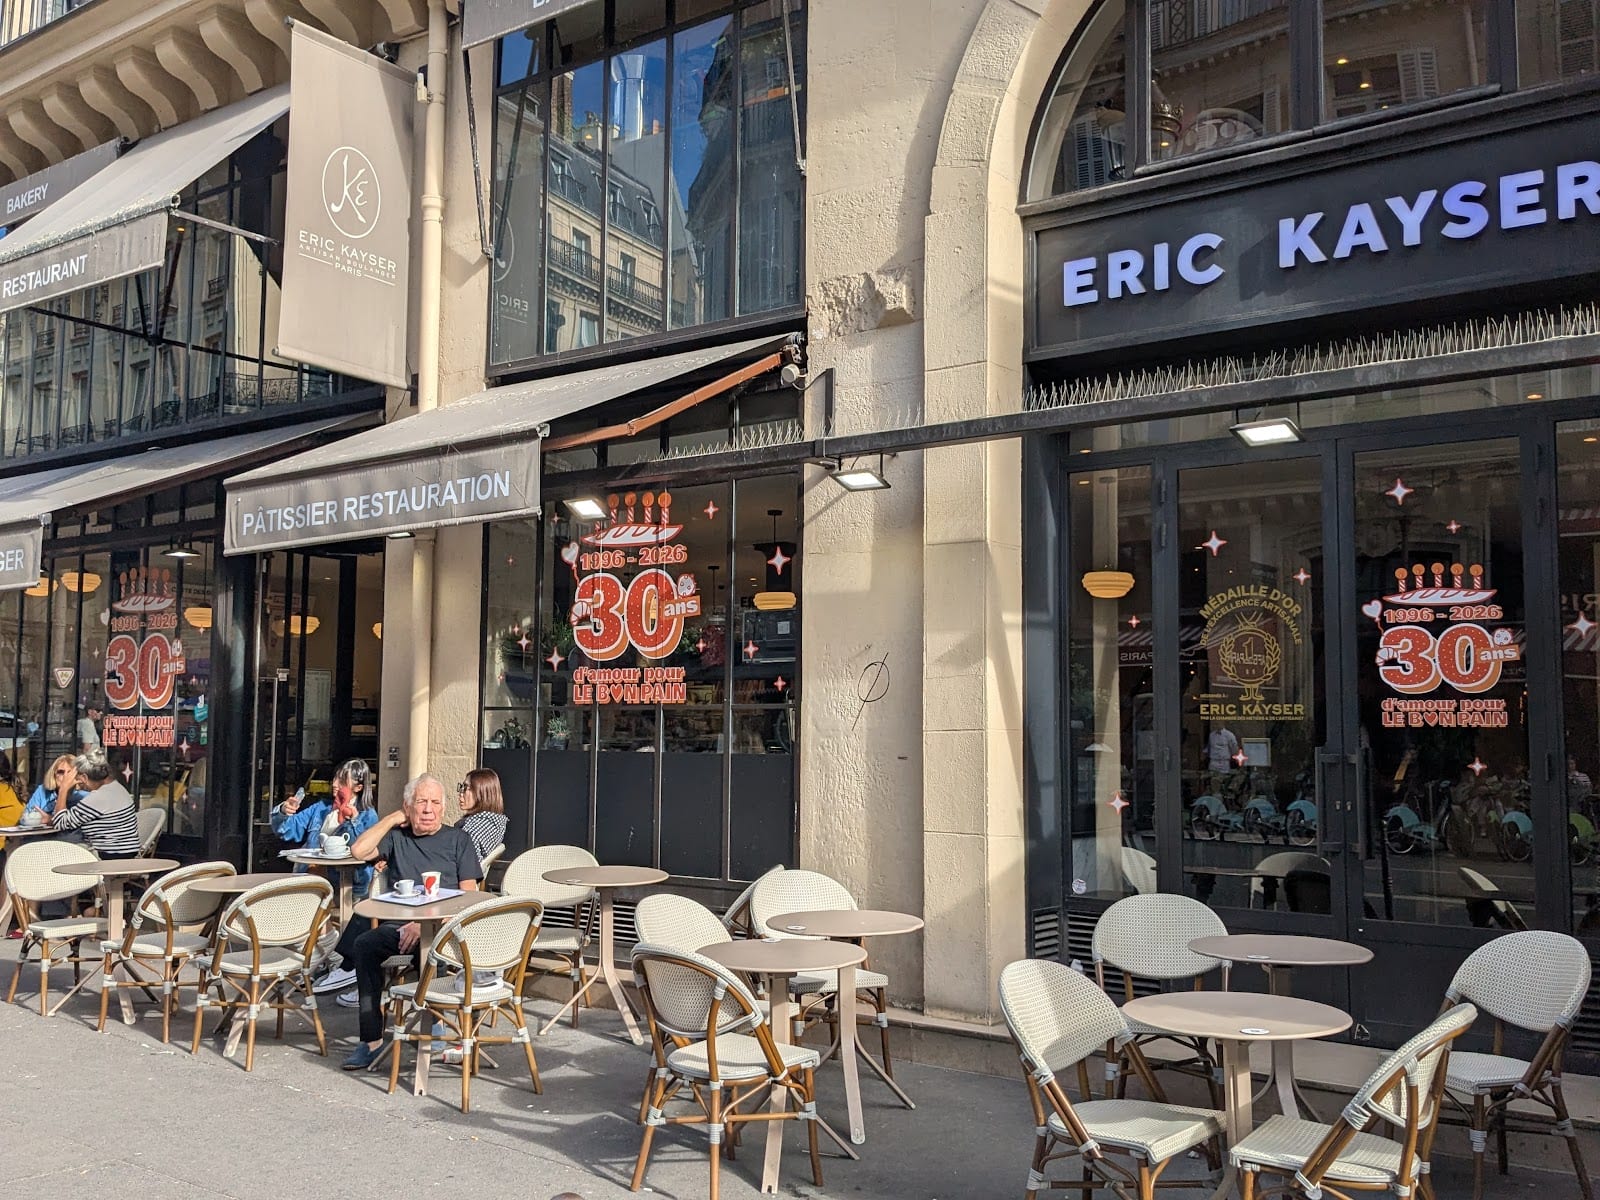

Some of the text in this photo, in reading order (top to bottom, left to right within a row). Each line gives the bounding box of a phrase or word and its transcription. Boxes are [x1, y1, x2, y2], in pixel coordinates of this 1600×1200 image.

[6, 183, 49, 214] BAKERY
[1063, 160, 1600, 307] ERIC KAYSER
[299, 230, 396, 272] ERIC KAYSER
[299, 244, 396, 279] ARTISAN BOULANGER
[2, 254, 88, 298] RESTAURANT
[335, 262, 362, 277] PARIS
[242, 470, 511, 536] PÂTISSIER RESTAURATION
[580, 550, 625, 570] 1996
[638, 544, 688, 566] 2026
[664, 599, 698, 617] ans
[1199, 584, 1302, 619] MÉDAILLE D'OR
[111, 616, 139, 632] 1996
[147, 613, 178, 630] 2026
[573, 568, 685, 661] 30
[1200, 599, 1302, 646] DE L'EXCELLENCE ARTISANALE
[1384, 608, 1434, 623] 1996
[1449, 605, 1503, 621] 2026
[1379, 623, 1503, 694] 30
[1480, 648, 1517, 661] ans
[105, 632, 175, 710] 30
[162, 660, 184, 673] ans
[573, 666, 686, 683] d'amour pour
[573, 684, 594, 704] LE
[641, 682, 687, 704] PAIN
[1200, 703, 1305, 715] ERIC KAYSER
[1381, 698, 1507, 712] d'amour pour
[148, 716, 174, 729] pour
[1382, 712, 1405, 727] LE
[1457, 712, 1508, 728] PAIN
[103, 729, 117, 746] LE
[146, 728, 175, 746] PAIN
